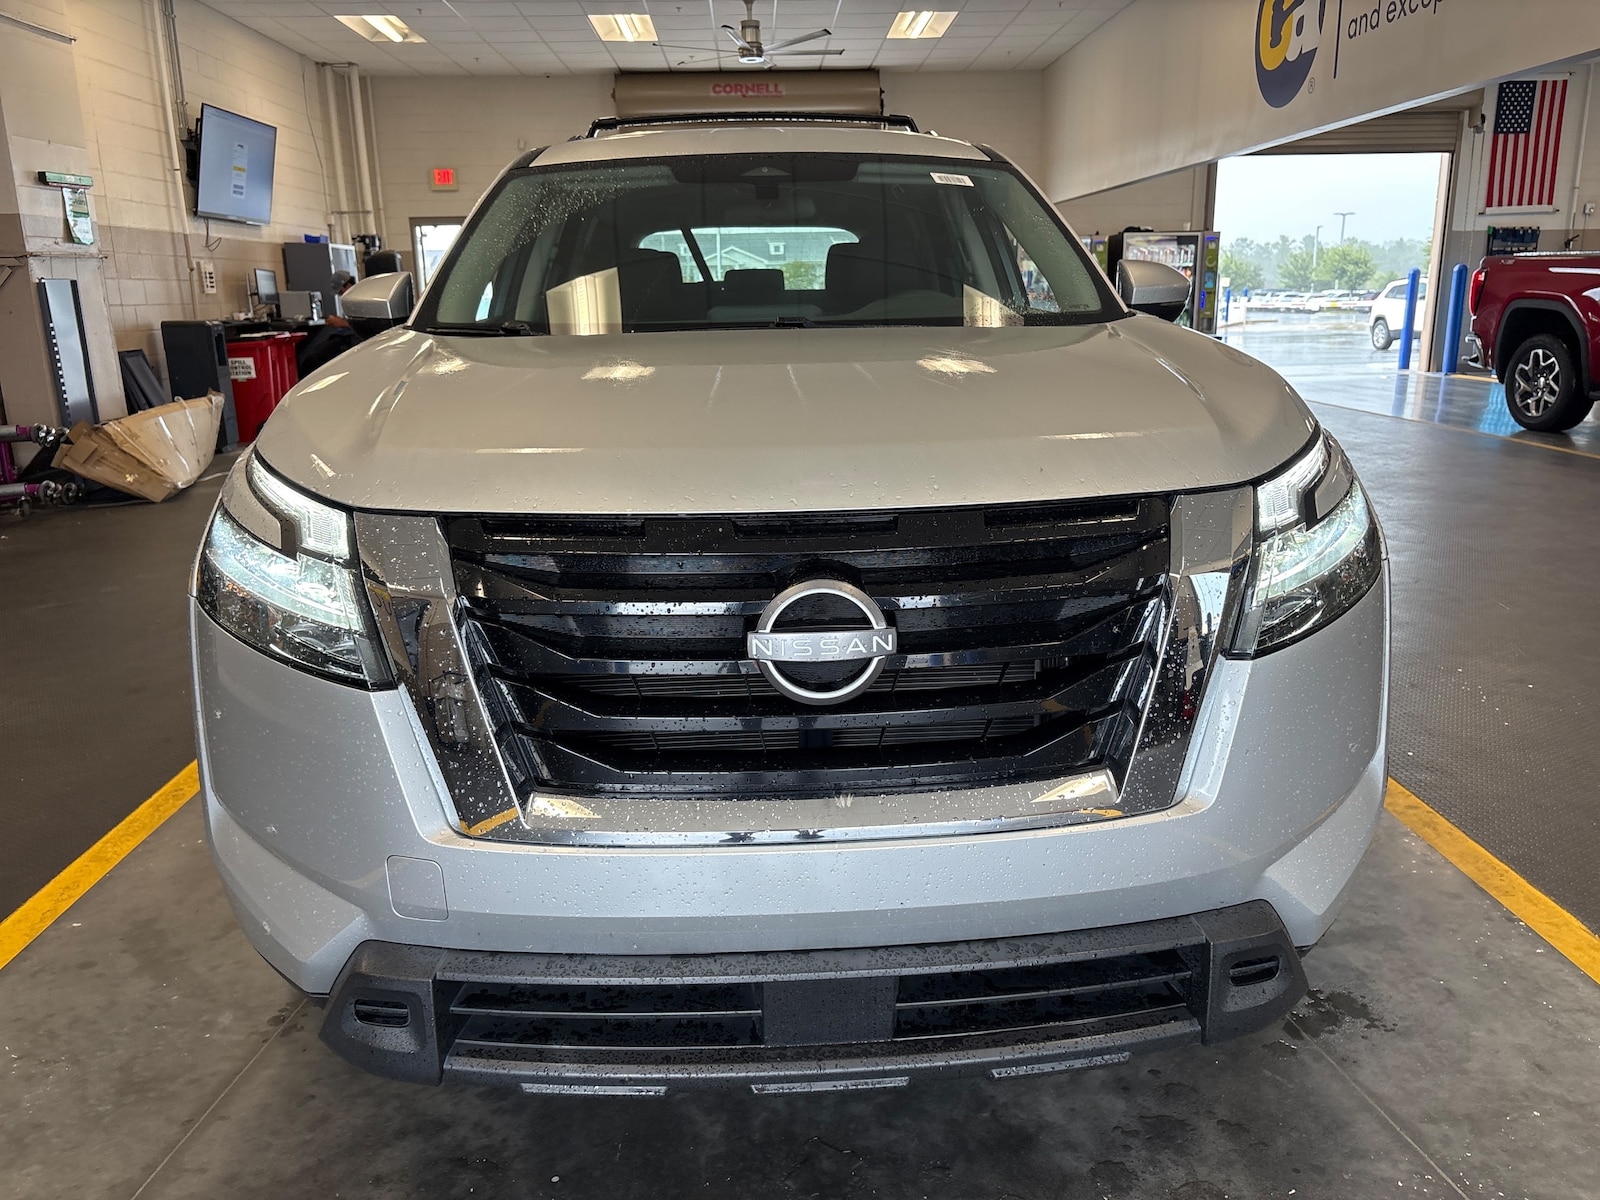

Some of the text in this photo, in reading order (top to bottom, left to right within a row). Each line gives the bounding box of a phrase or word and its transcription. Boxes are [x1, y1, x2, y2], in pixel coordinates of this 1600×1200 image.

[1348, 0, 1381, 39] and
[711, 82, 783, 95] CORNELL
[751, 634, 894, 657] NISSAN
